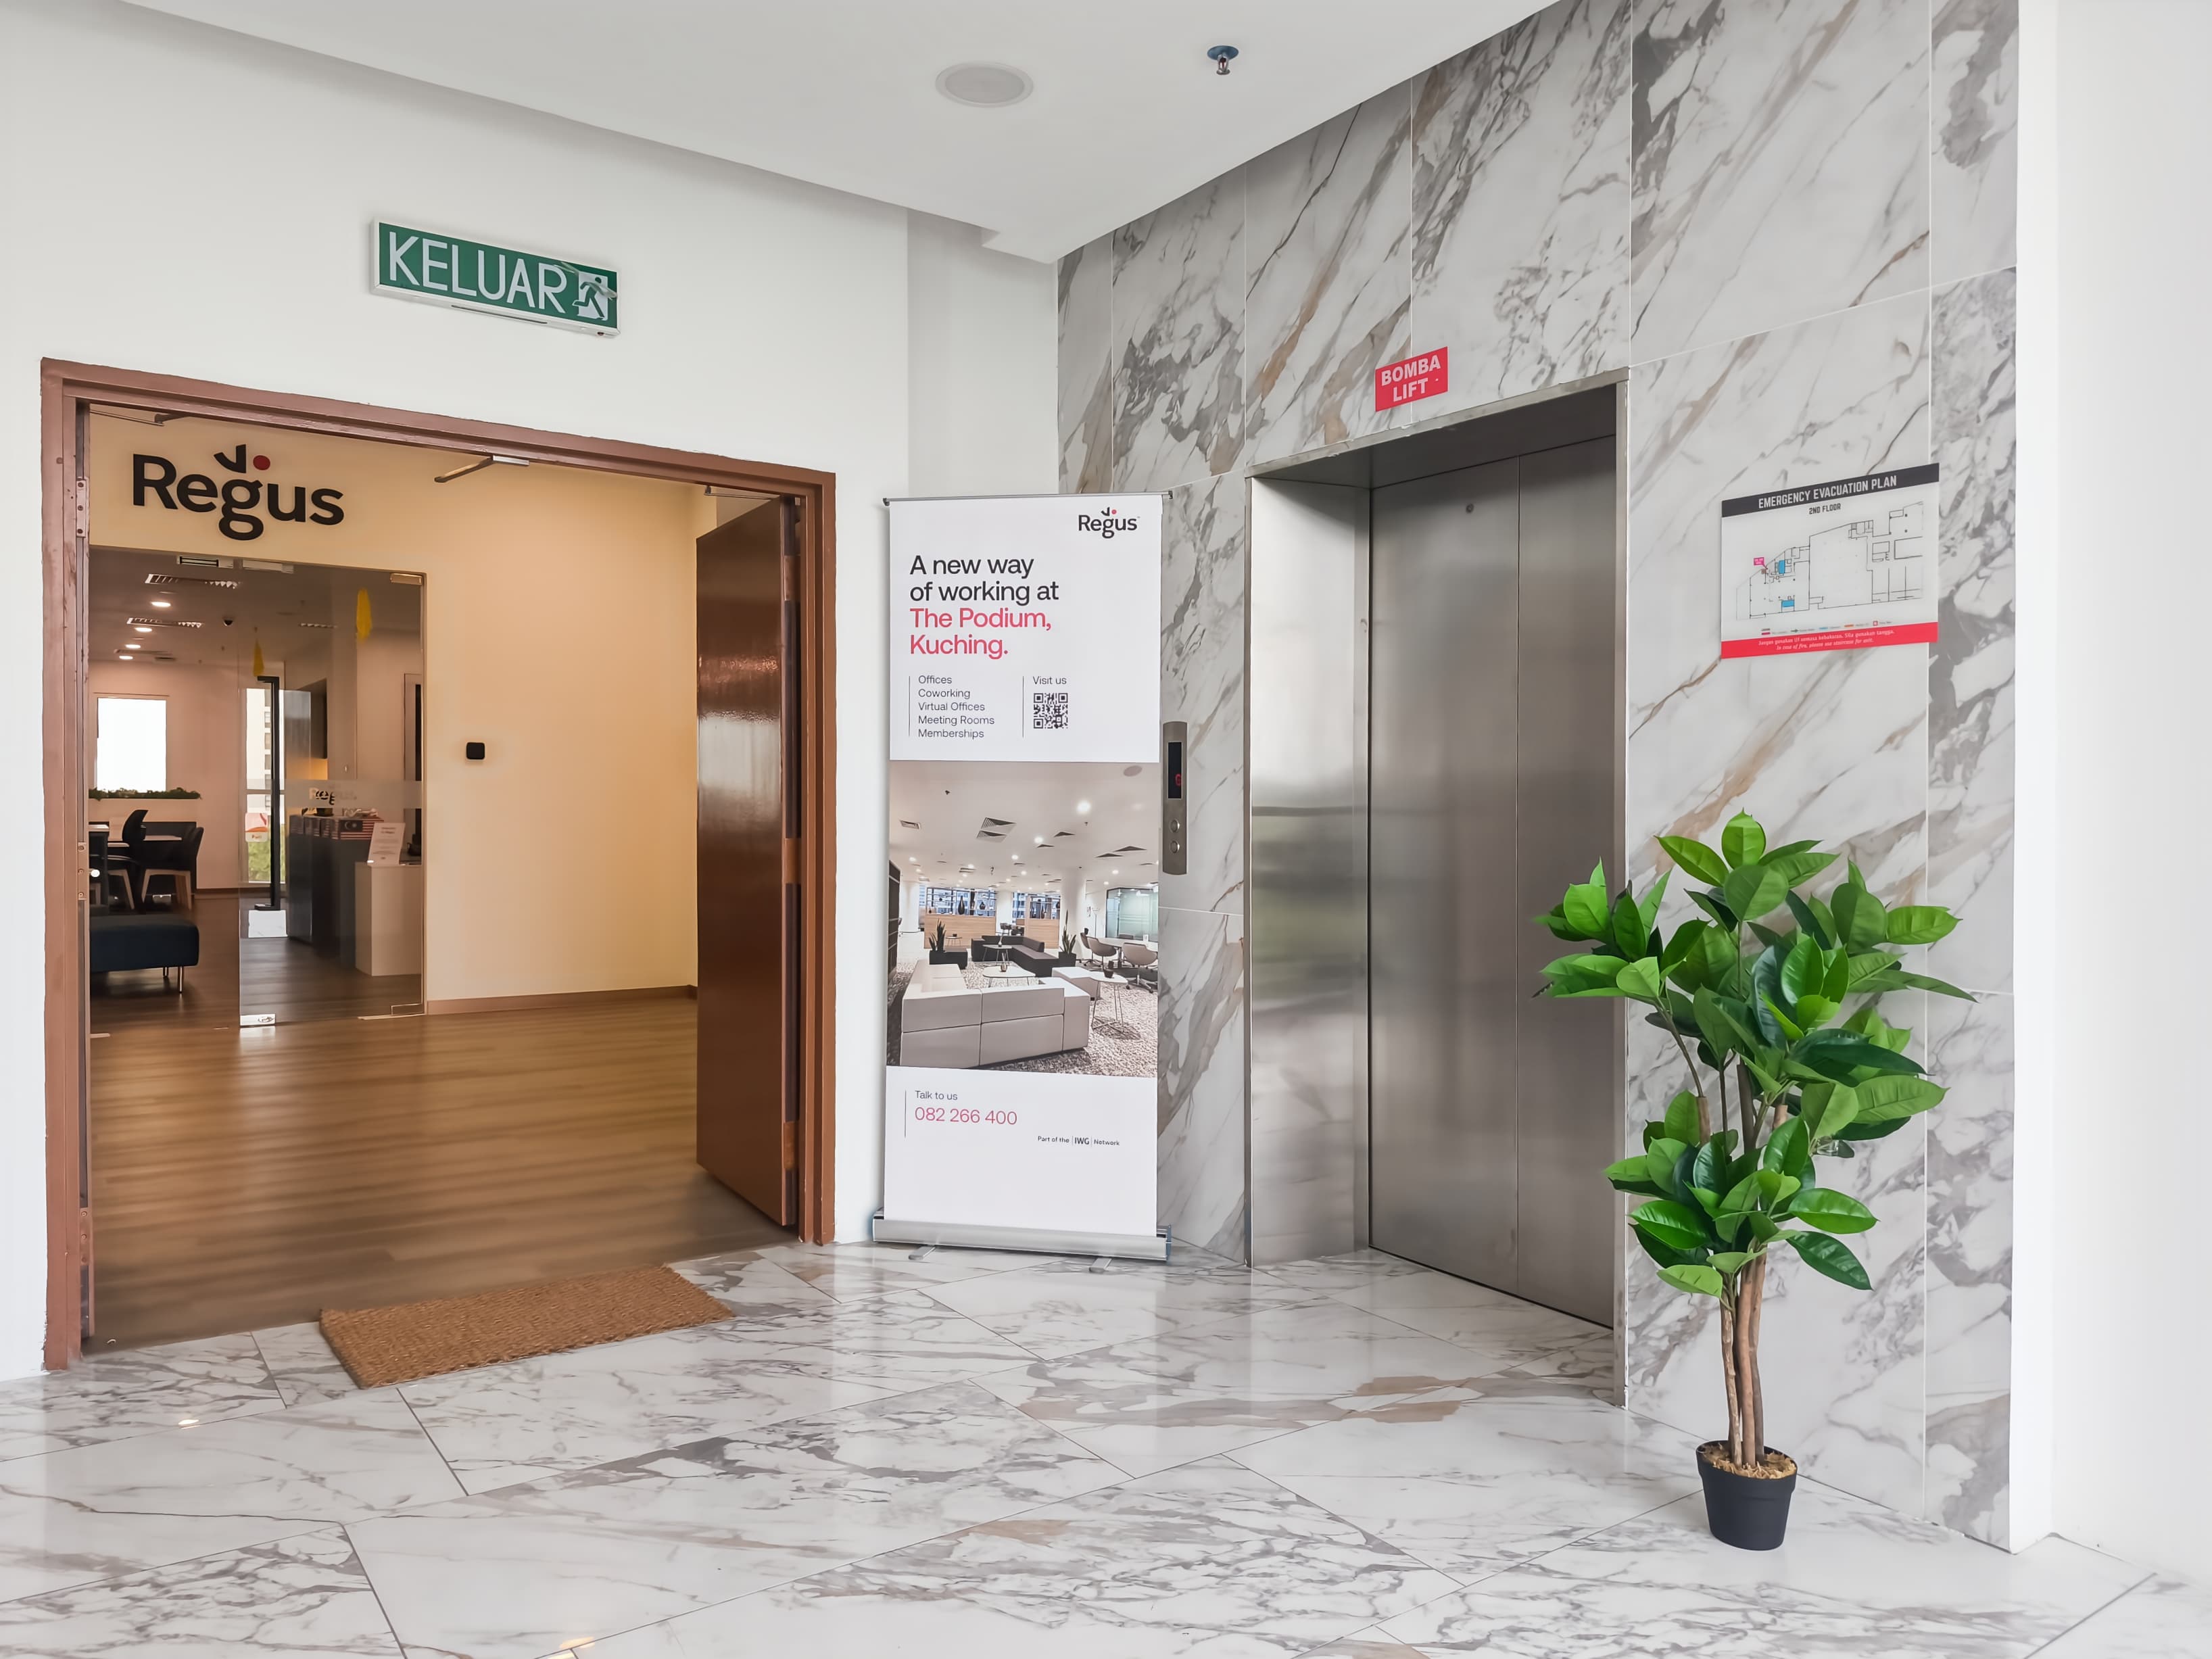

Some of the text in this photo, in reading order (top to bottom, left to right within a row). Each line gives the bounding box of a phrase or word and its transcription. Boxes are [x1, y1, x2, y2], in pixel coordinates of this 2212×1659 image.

[389, 231, 566, 313] KELUAR
[1381, 355, 1441, 386] BOMBA
[1393, 378, 1428, 402] LIFT
[133, 444, 344, 541] Regus
[1758, 475, 1896, 508] EMERGENCY EVACUATION PLAN
[1809, 503, 1841, 514] 2ND FLOOR
[1078, 507, 1138, 539] Regus
[910, 555, 1034, 579] A new way
[910, 581, 1059, 606] of working at
[910, 608, 1051, 631] The Podium,
[910, 634, 1008, 659] Kuching.
[918, 675, 953, 683] Offices
[1032, 676, 1053, 684] Visit
[918, 689, 970, 699] Coworking
[918, 702, 985, 711] Virtual Offices
[918, 716, 994, 726] Meeting Rooms
[918, 729, 984, 740] Memberships
[915, 1090, 932, 1099] Talk
[935, 1092, 944, 1100] to
[915, 1107, 1017, 1125] 082 266 400
